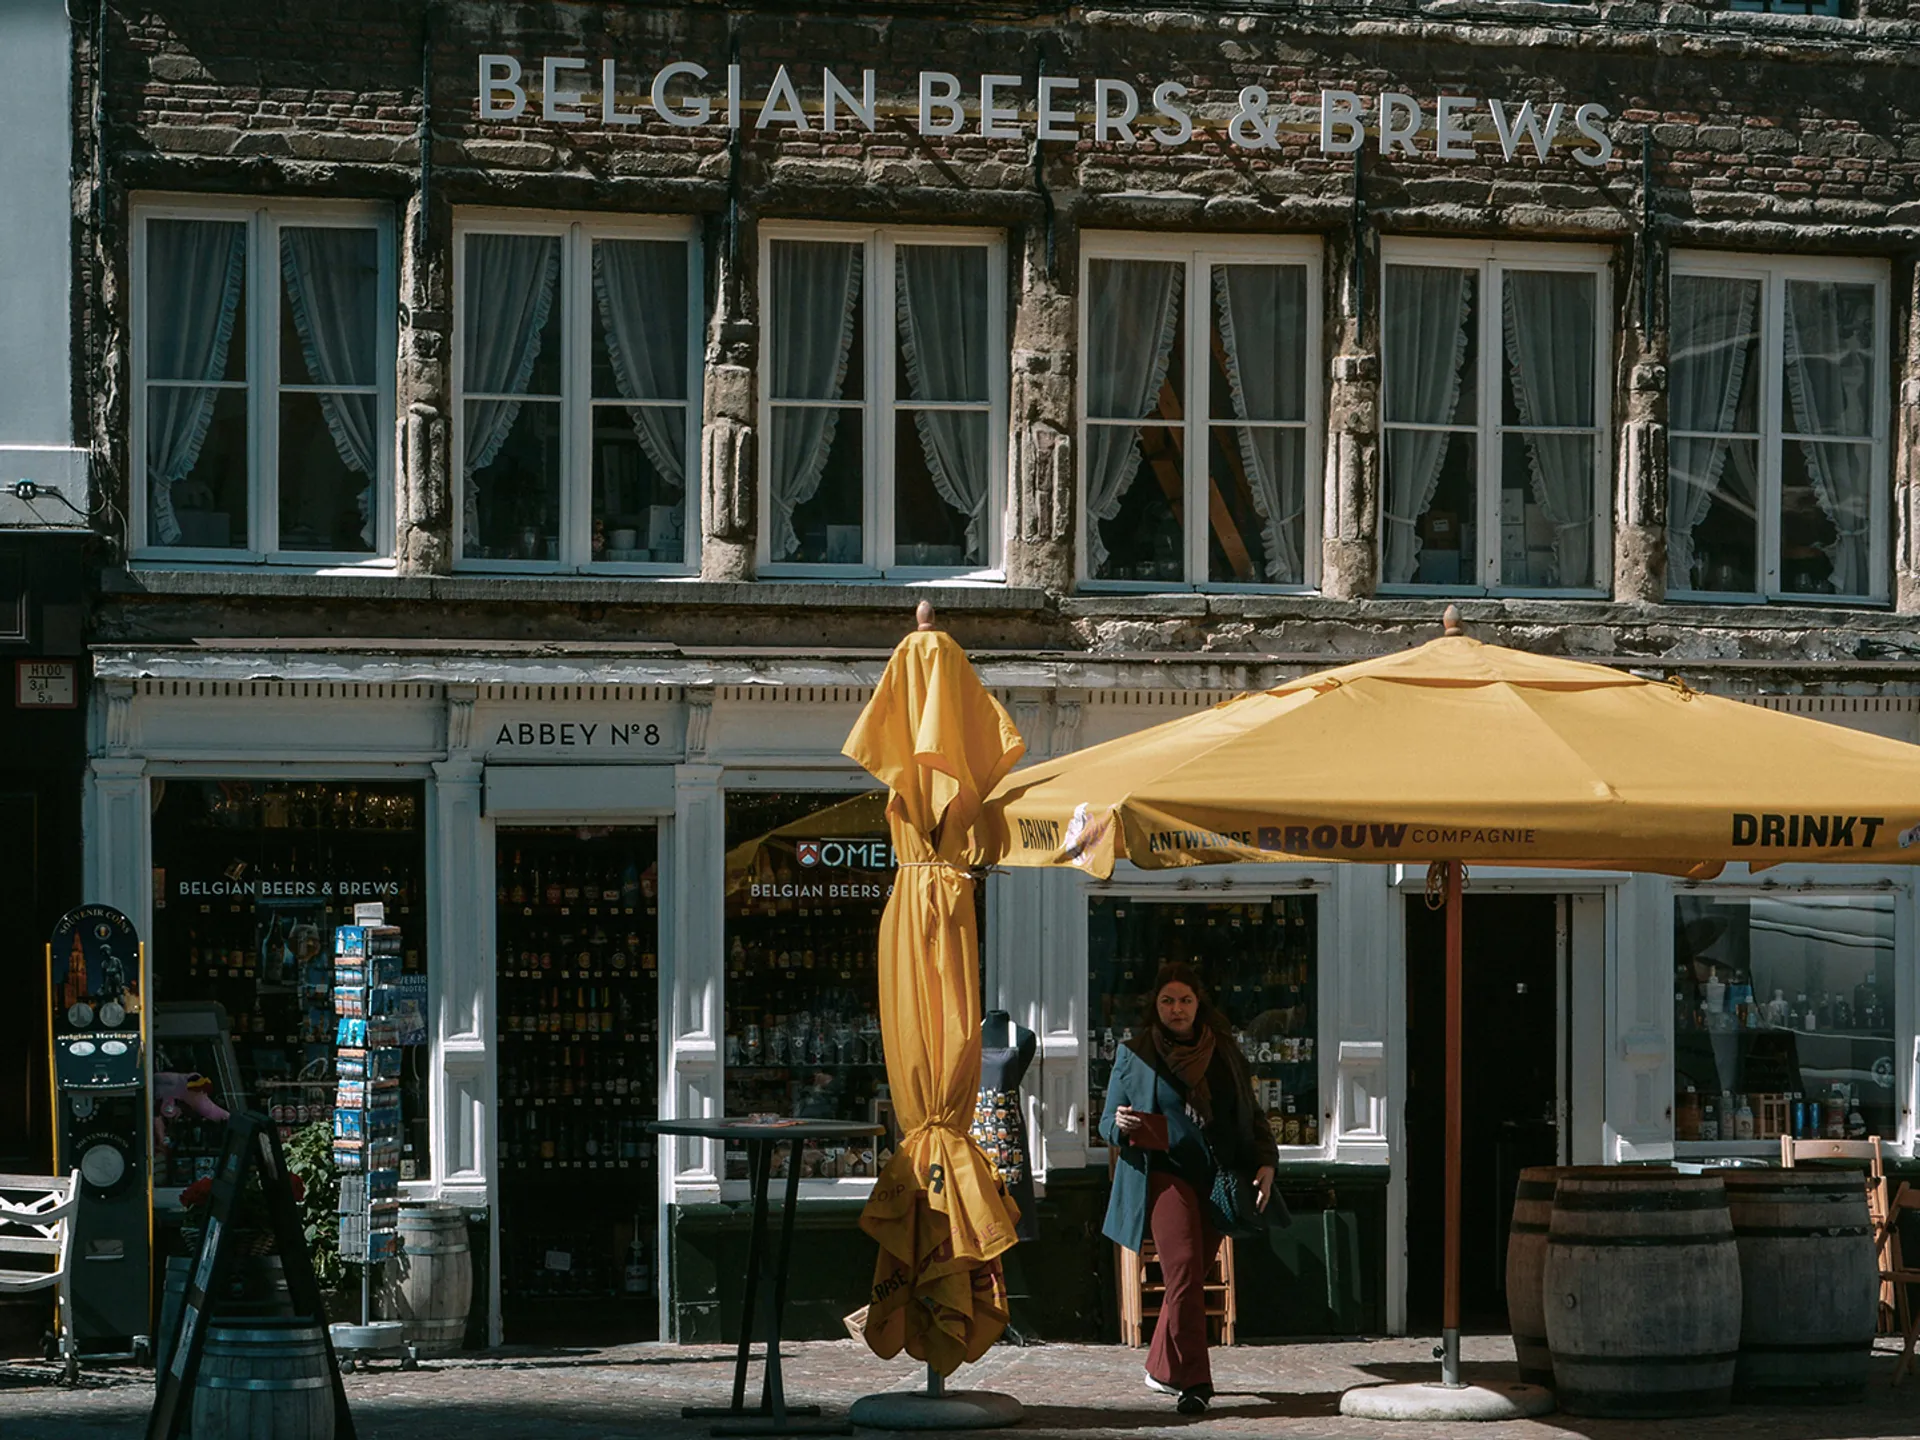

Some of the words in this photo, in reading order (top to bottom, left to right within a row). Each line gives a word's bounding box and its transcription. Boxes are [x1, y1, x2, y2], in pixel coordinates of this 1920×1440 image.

[479, 54, 876, 134] BELGIAN
[919, 71, 1193, 146] BEERS
[1228, 85, 1282, 150] &
[1320, 89, 1613, 166] BREWS
[31, 664, 62, 676] H100
[496, 724, 598, 746] ABBEY
[1018, 818, 1060, 851] DRINKT
[1258, 822, 1408, 851] BROUW
[1412, 829, 1536, 843] COMPAGNIE
[1732, 813, 1885, 848] DRINKT
[180, 882, 255, 895] BELGIAN
[262, 882, 316, 895] BEERS
[321, 882, 332, 895] &
[340, 882, 399, 895] BREWS
[751, 884, 823, 897] BELGIAN
[829, 884, 881, 898] BEERS
[60, 909, 104, 935] SOUVENIR
[105, 911, 131, 934] COINS
